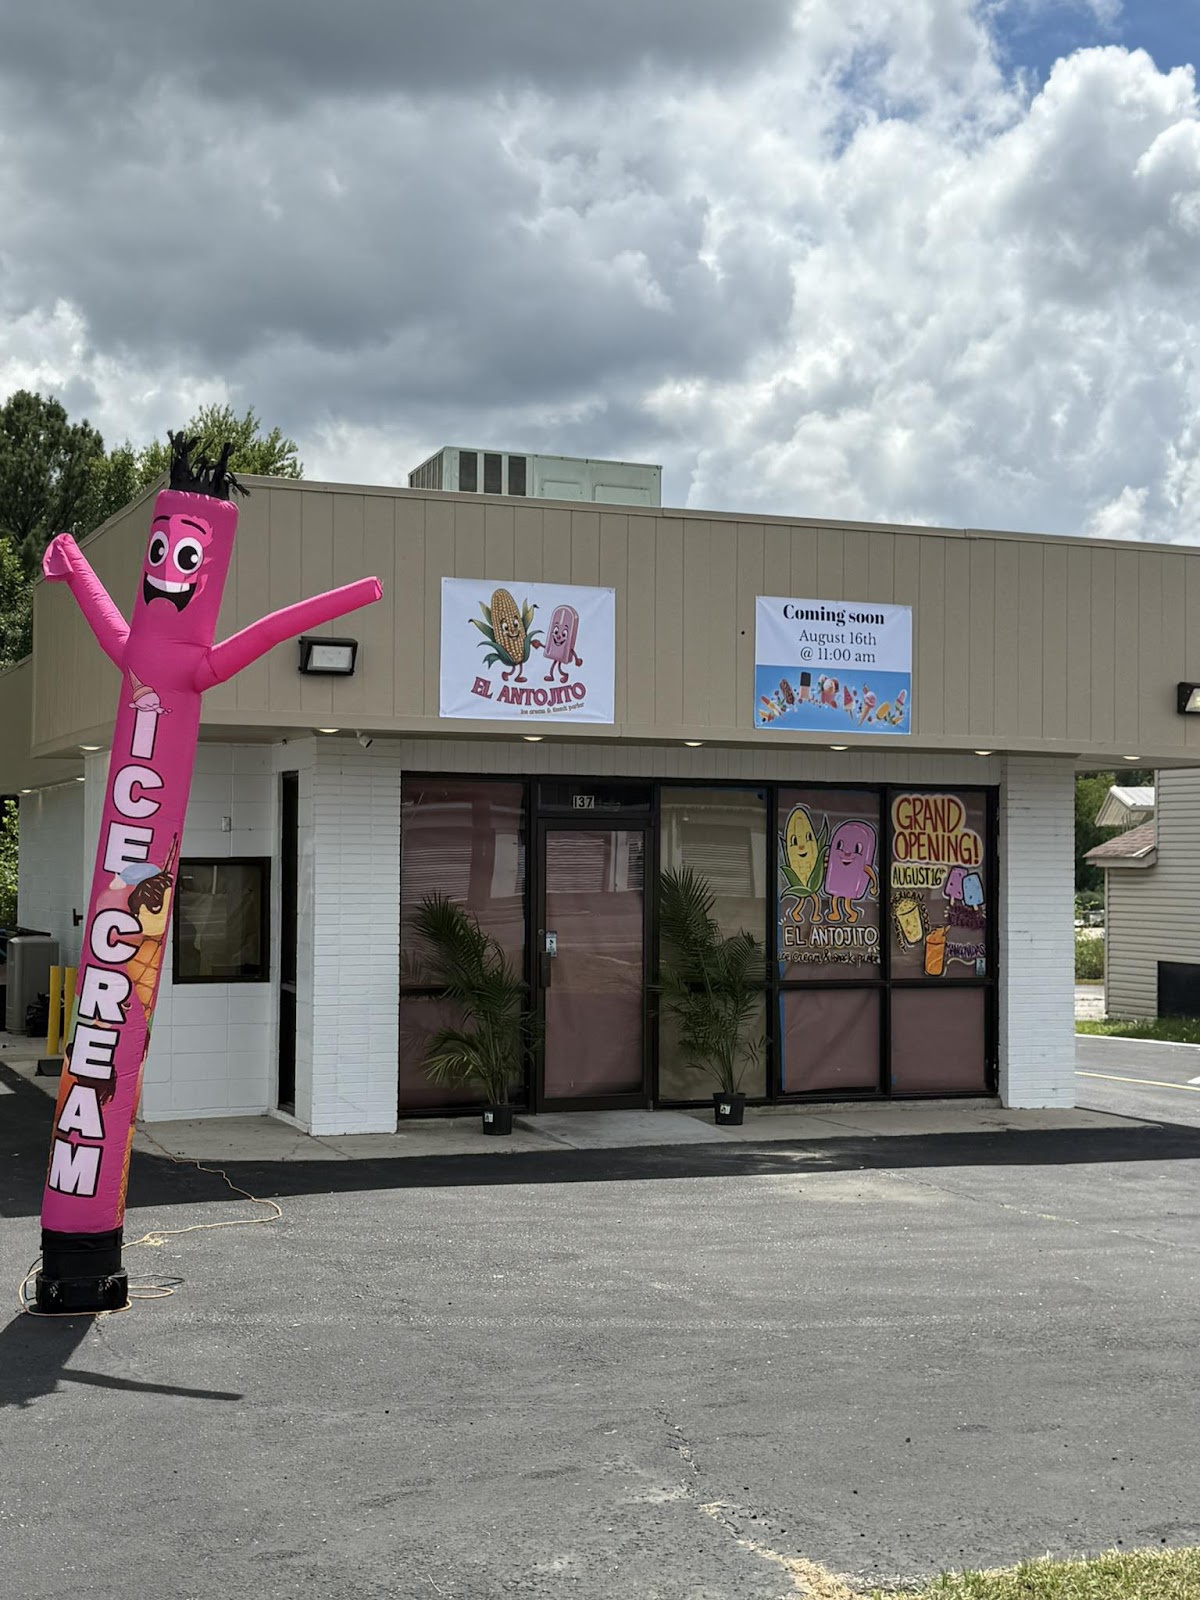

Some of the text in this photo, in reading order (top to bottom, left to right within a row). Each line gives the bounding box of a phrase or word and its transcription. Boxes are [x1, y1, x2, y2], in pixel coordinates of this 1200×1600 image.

[783, 604, 885, 627] Coming soon
[800, 630, 877, 646] August 16th
[800, 647, 876, 663] @ 11:00 am
[471, 677, 586, 706] EL ANTOJITO
[574, 796, 593, 808] 137
[896, 797, 962, 834] GRAND
[894, 831, 980, 865] OPENING!
[892, 865, 931, 886] AUGUST
[784, 926, 806, 945] EL
[810, 926, 877, 946] ANTOJITO
[48, 708, 164, 1198] ICE CREAM
